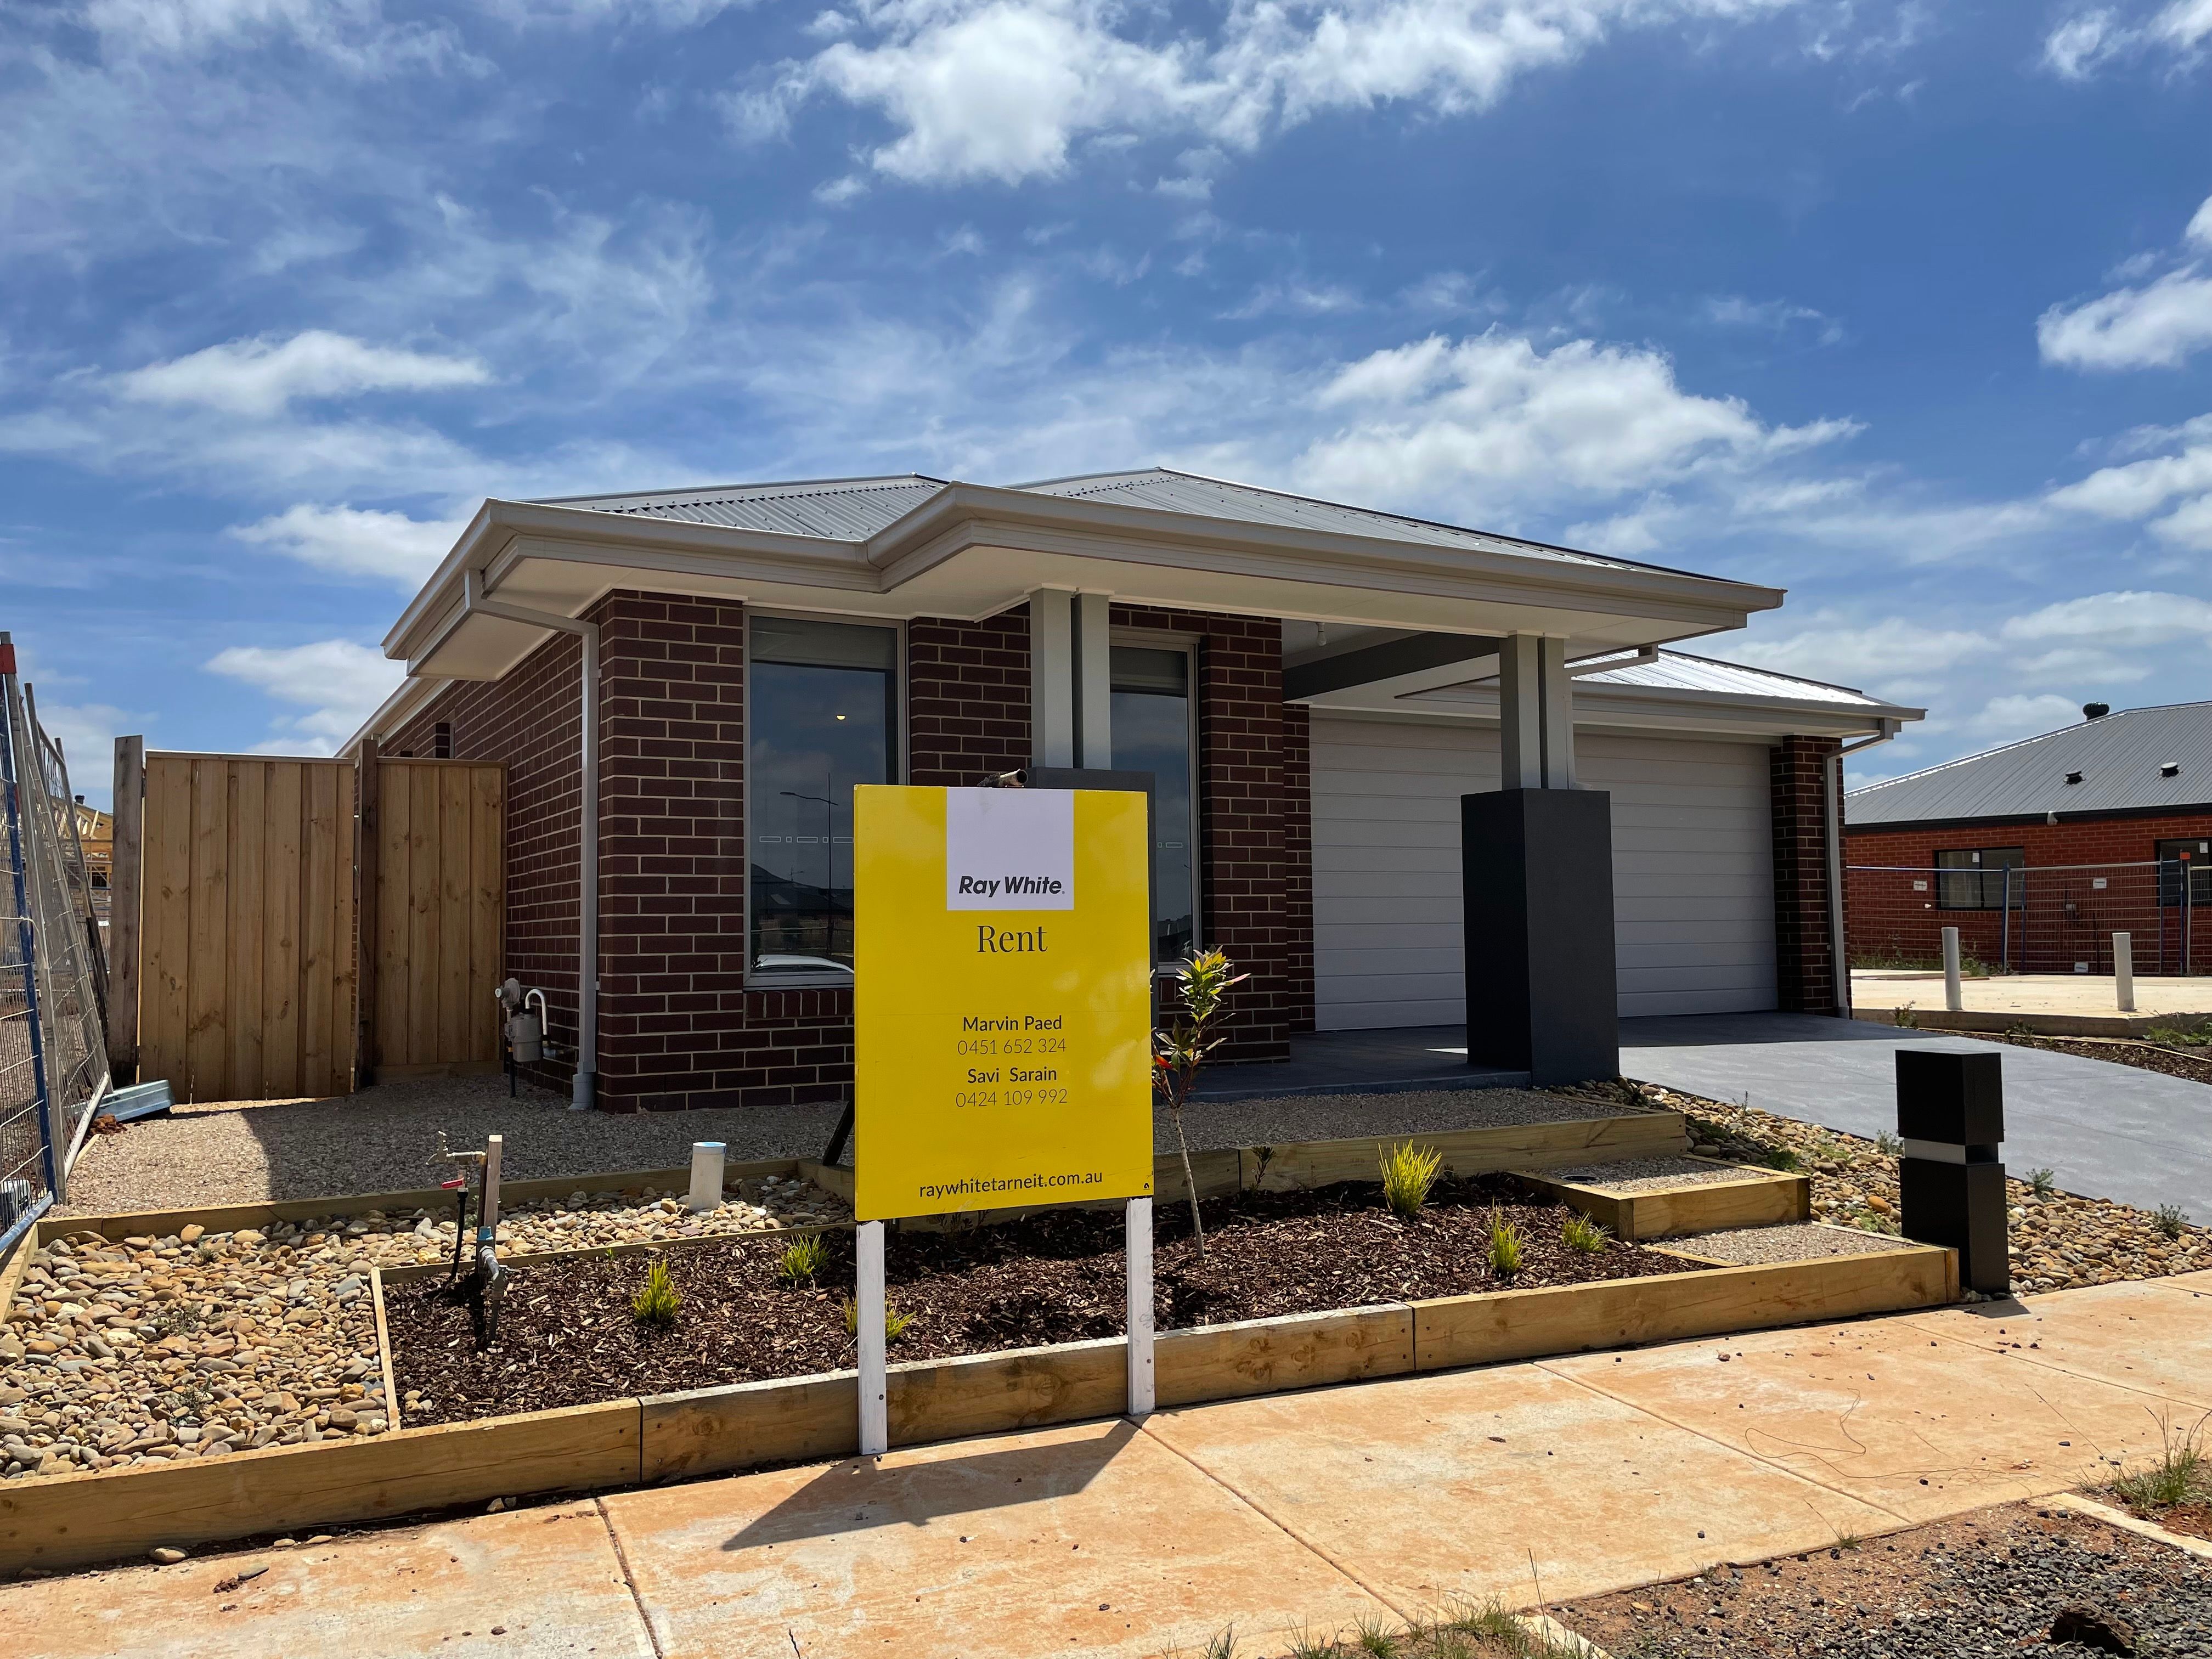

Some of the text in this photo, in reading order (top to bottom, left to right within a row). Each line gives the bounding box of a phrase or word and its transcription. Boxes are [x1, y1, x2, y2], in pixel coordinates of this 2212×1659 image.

[958, 876, 1001, 898] Ray
[977, 926, 1048, 953] Rent
[963, 1014, 1062, 1031] Marvin Paed
[957, 1038, 1067, 1055] 0451 652 324
[967, 1066, 1057, 1084] Savi Sarain
[956, 1088, 1068, 1108] 0424 109 992
[919, 1172, 1103, 1199] raywhitetarneit.com.au
